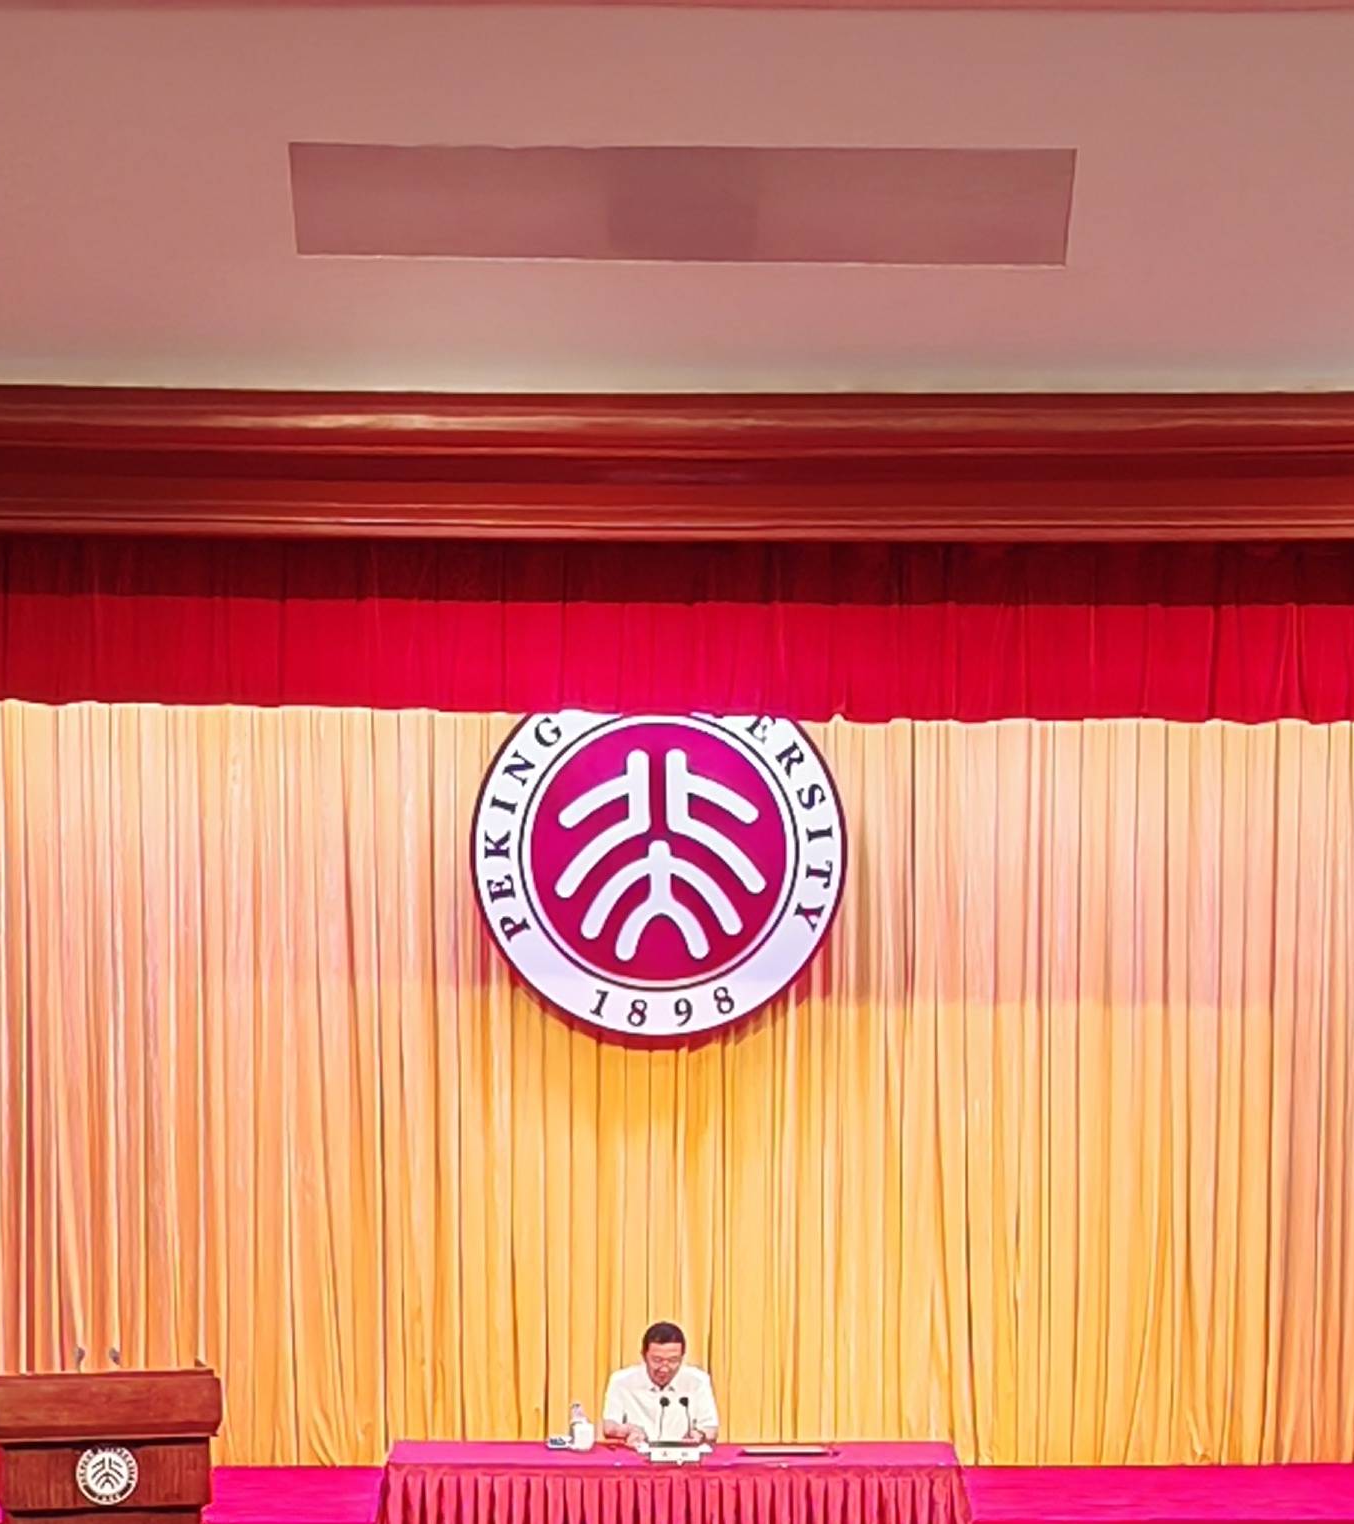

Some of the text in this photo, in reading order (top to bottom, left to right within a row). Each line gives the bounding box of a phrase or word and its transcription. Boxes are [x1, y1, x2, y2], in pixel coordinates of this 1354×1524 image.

[484, 715, 835, 942] PEKING ERSITY
[588, 986, 736, 1028] 1898
